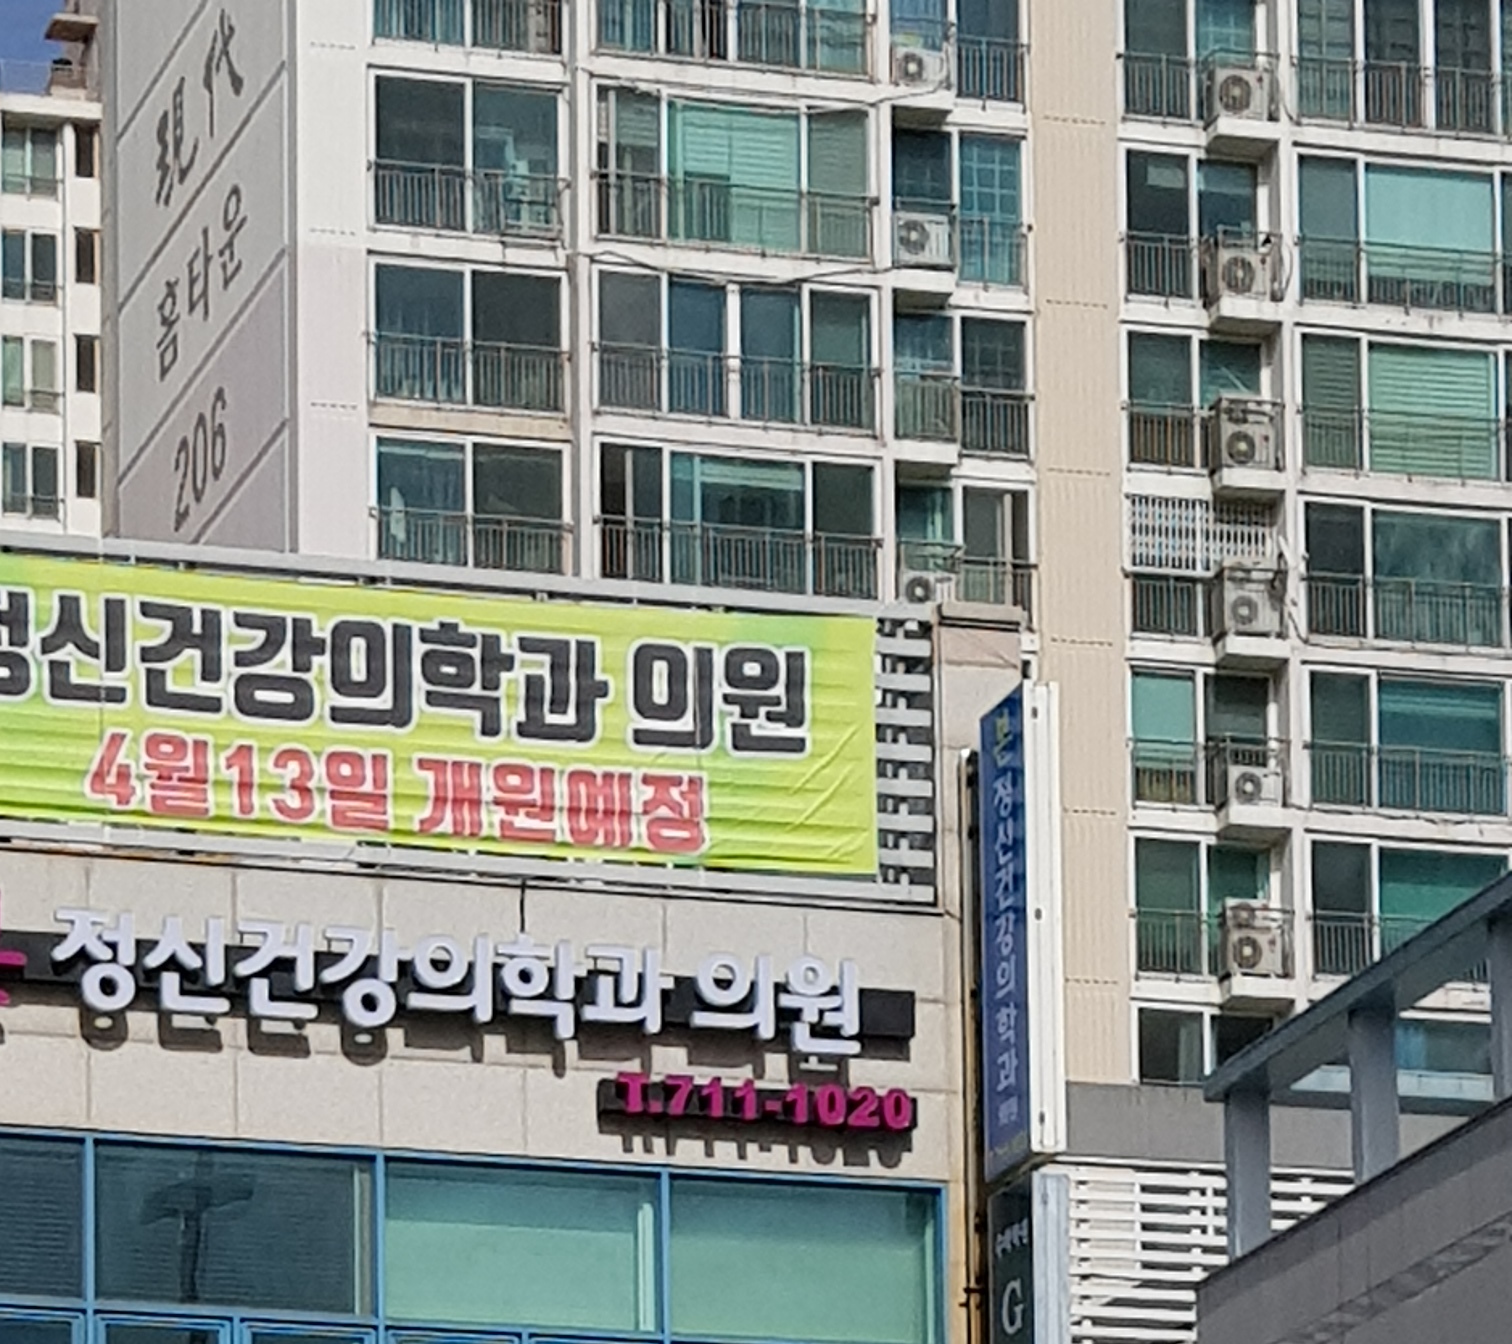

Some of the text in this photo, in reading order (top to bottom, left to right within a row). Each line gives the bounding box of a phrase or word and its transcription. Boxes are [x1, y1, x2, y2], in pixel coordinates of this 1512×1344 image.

[157, 184, 248, 382] 홈타운
[174, 387, 228, 532] 206
[632, 641, 808, 753] 의원
[89, 730, 708, 853] 4월13일 개원예정
[52, 905, 670, 1040] 정신건강의학과
[694, 954, 861, 1055] 의원
[618, 1072, 914, 1131] T.711-1020
